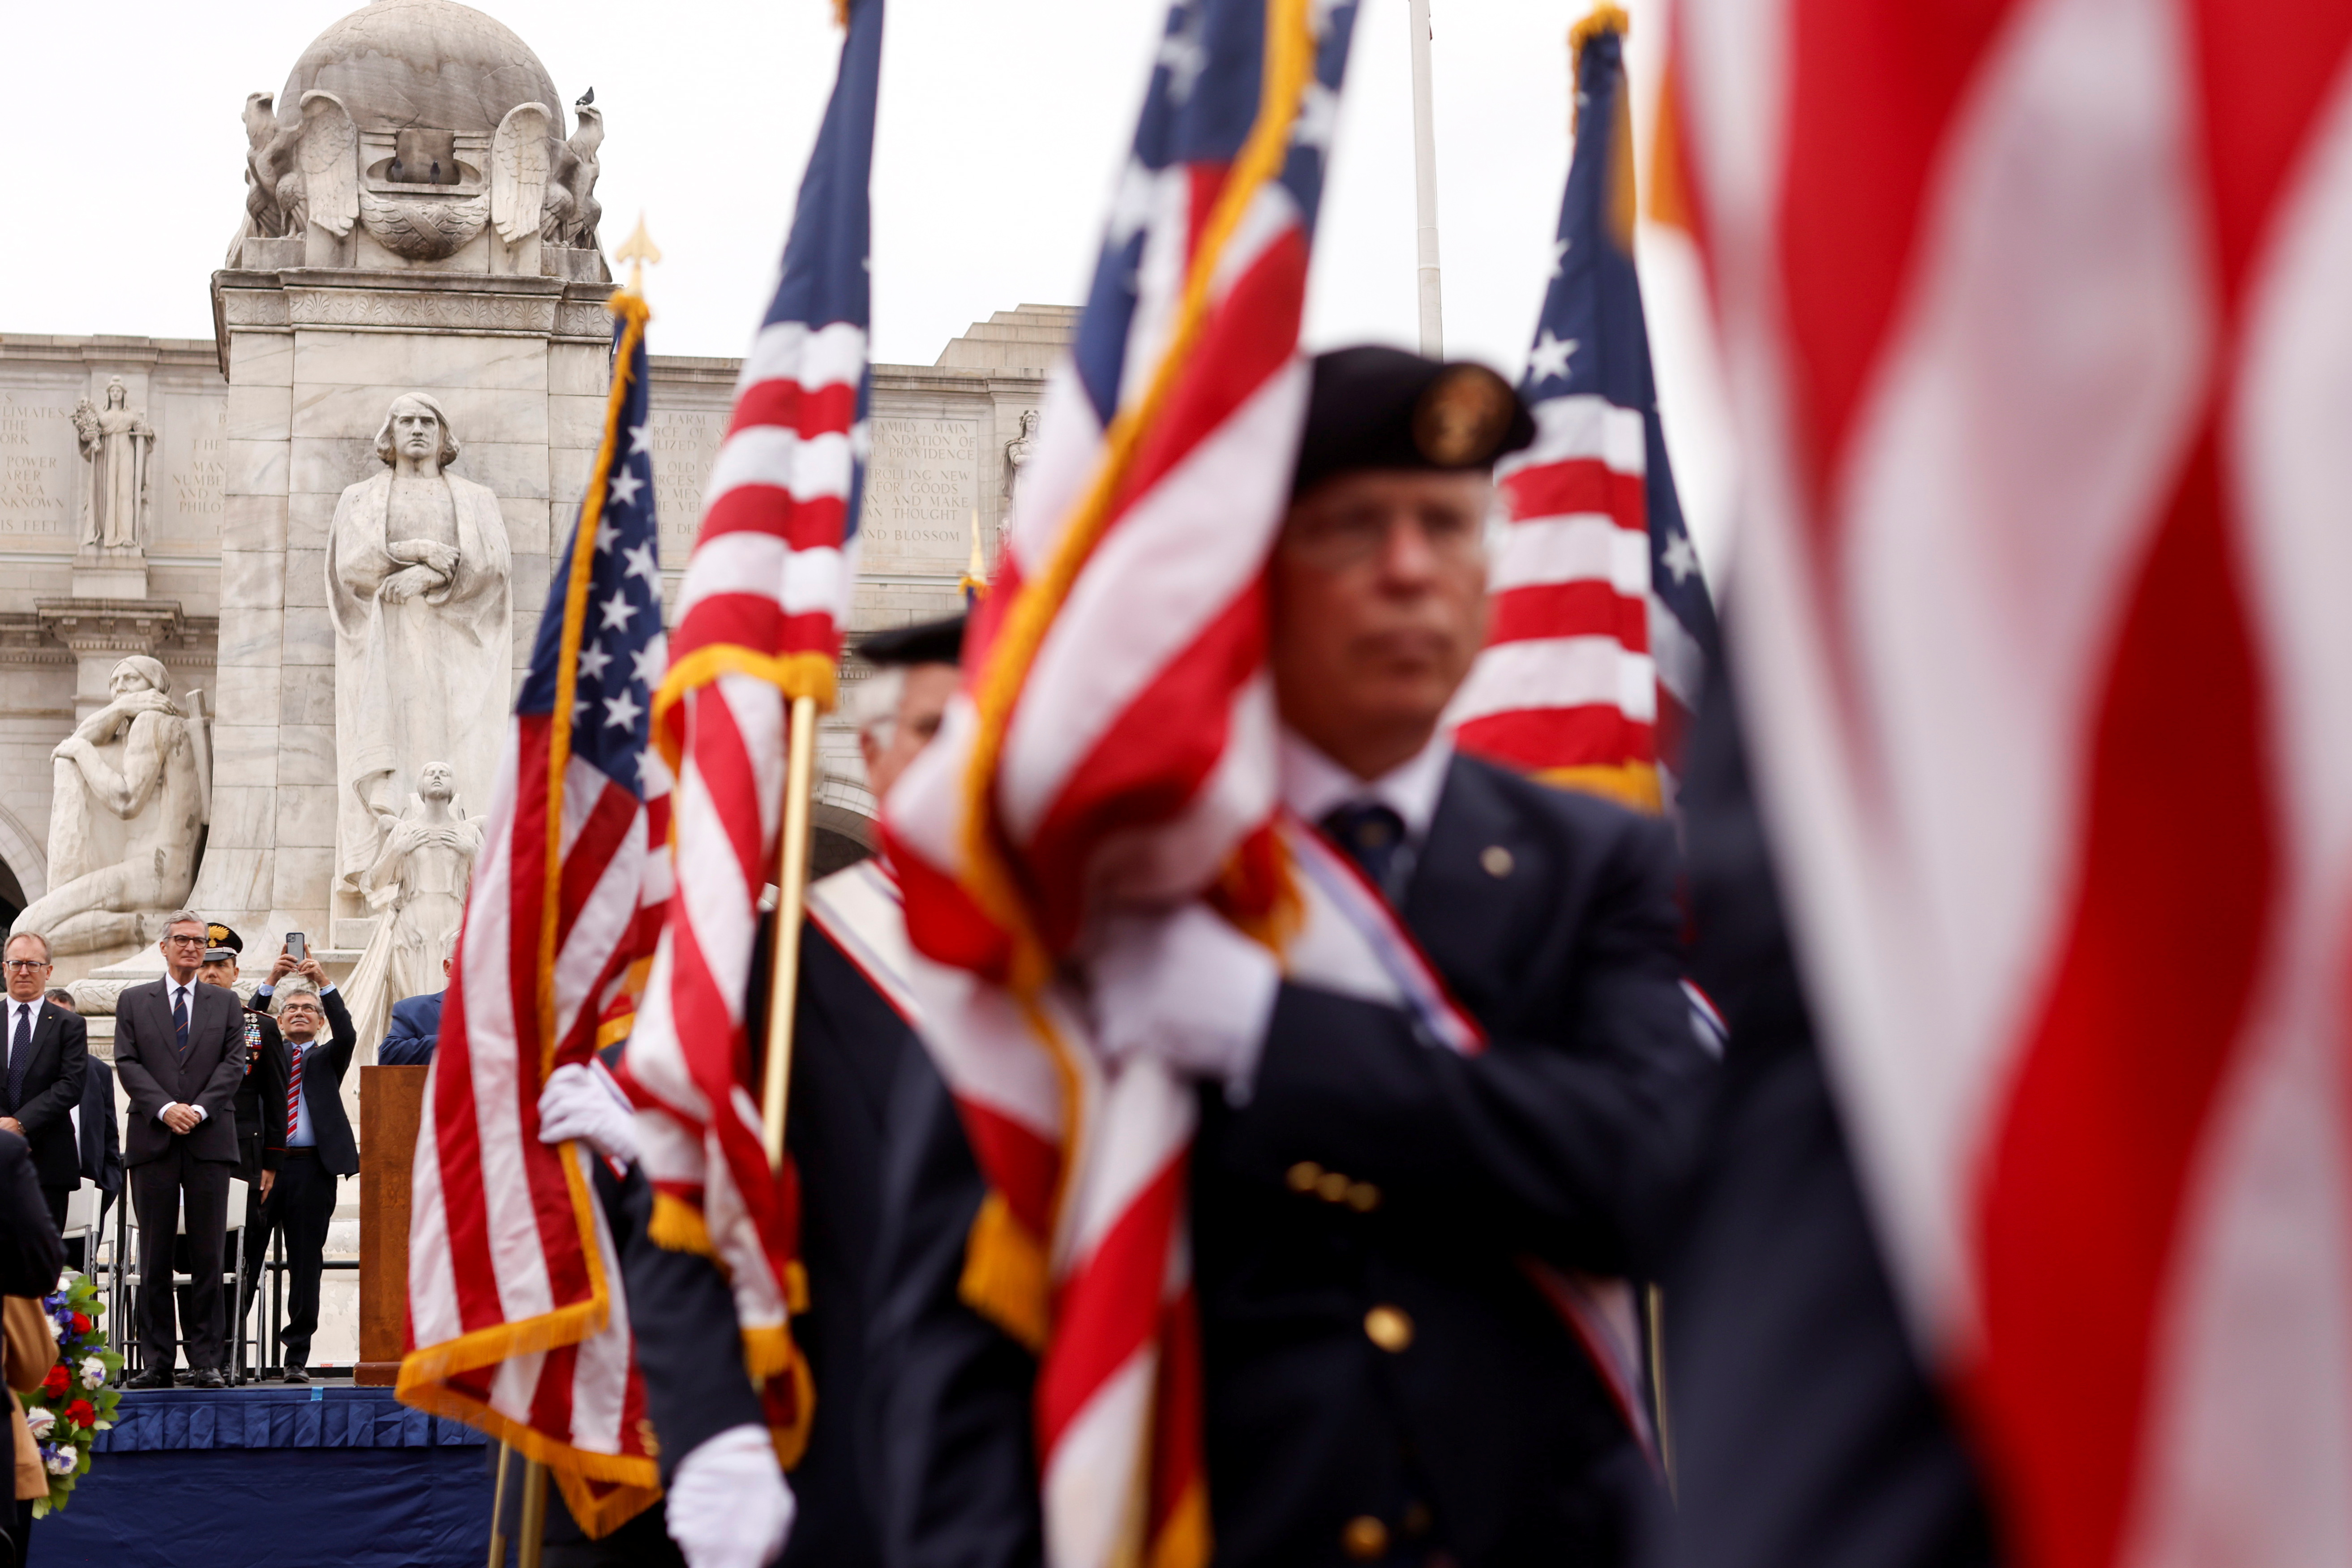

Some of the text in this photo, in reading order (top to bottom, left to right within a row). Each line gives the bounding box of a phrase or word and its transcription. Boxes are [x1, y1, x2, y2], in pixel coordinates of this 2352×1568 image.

[2, 406, 65, 418] LIMATES
[668, 414, 705, 425] FARM
[653, 426, 679, 437] RCE
[690, 427, 706, 438] OF
[871, 421, 968, 433] FAMILY MAIN
[0, 433, 29, 445] ORK
[191, 438, 221, 450] THE
[653, 439, 697, 451] ILIZED
[959, 436, 976, 447] OF
[889, 447, 975, 460] PROVIDENCE
[7, 456, 56, 468] POWER
[667, 461, 694, 473] OLD
[4, 470, 40, 481] ARER
[172, 474, 223, 486] NUMBE
[867, 468, 970, 482] TROLLING NEW
[16, 483, 44, 495] SEA
[176, 488, 208, 499] AND
[876, 481, 900, 493] FOR
[911, 482, 958, 494] GOODS
[0, 497, 64, 508] NKNOWN
[179, 501, 225, 513] PHILO
[891, 495, 921, 506] AND
[930, 496, 968, 508] MAKE
[892, 508, 958, 521] THOUGHT
[24, 520, 57, 532] FEET
[895, 530, 960, 542] BLOSSOM
